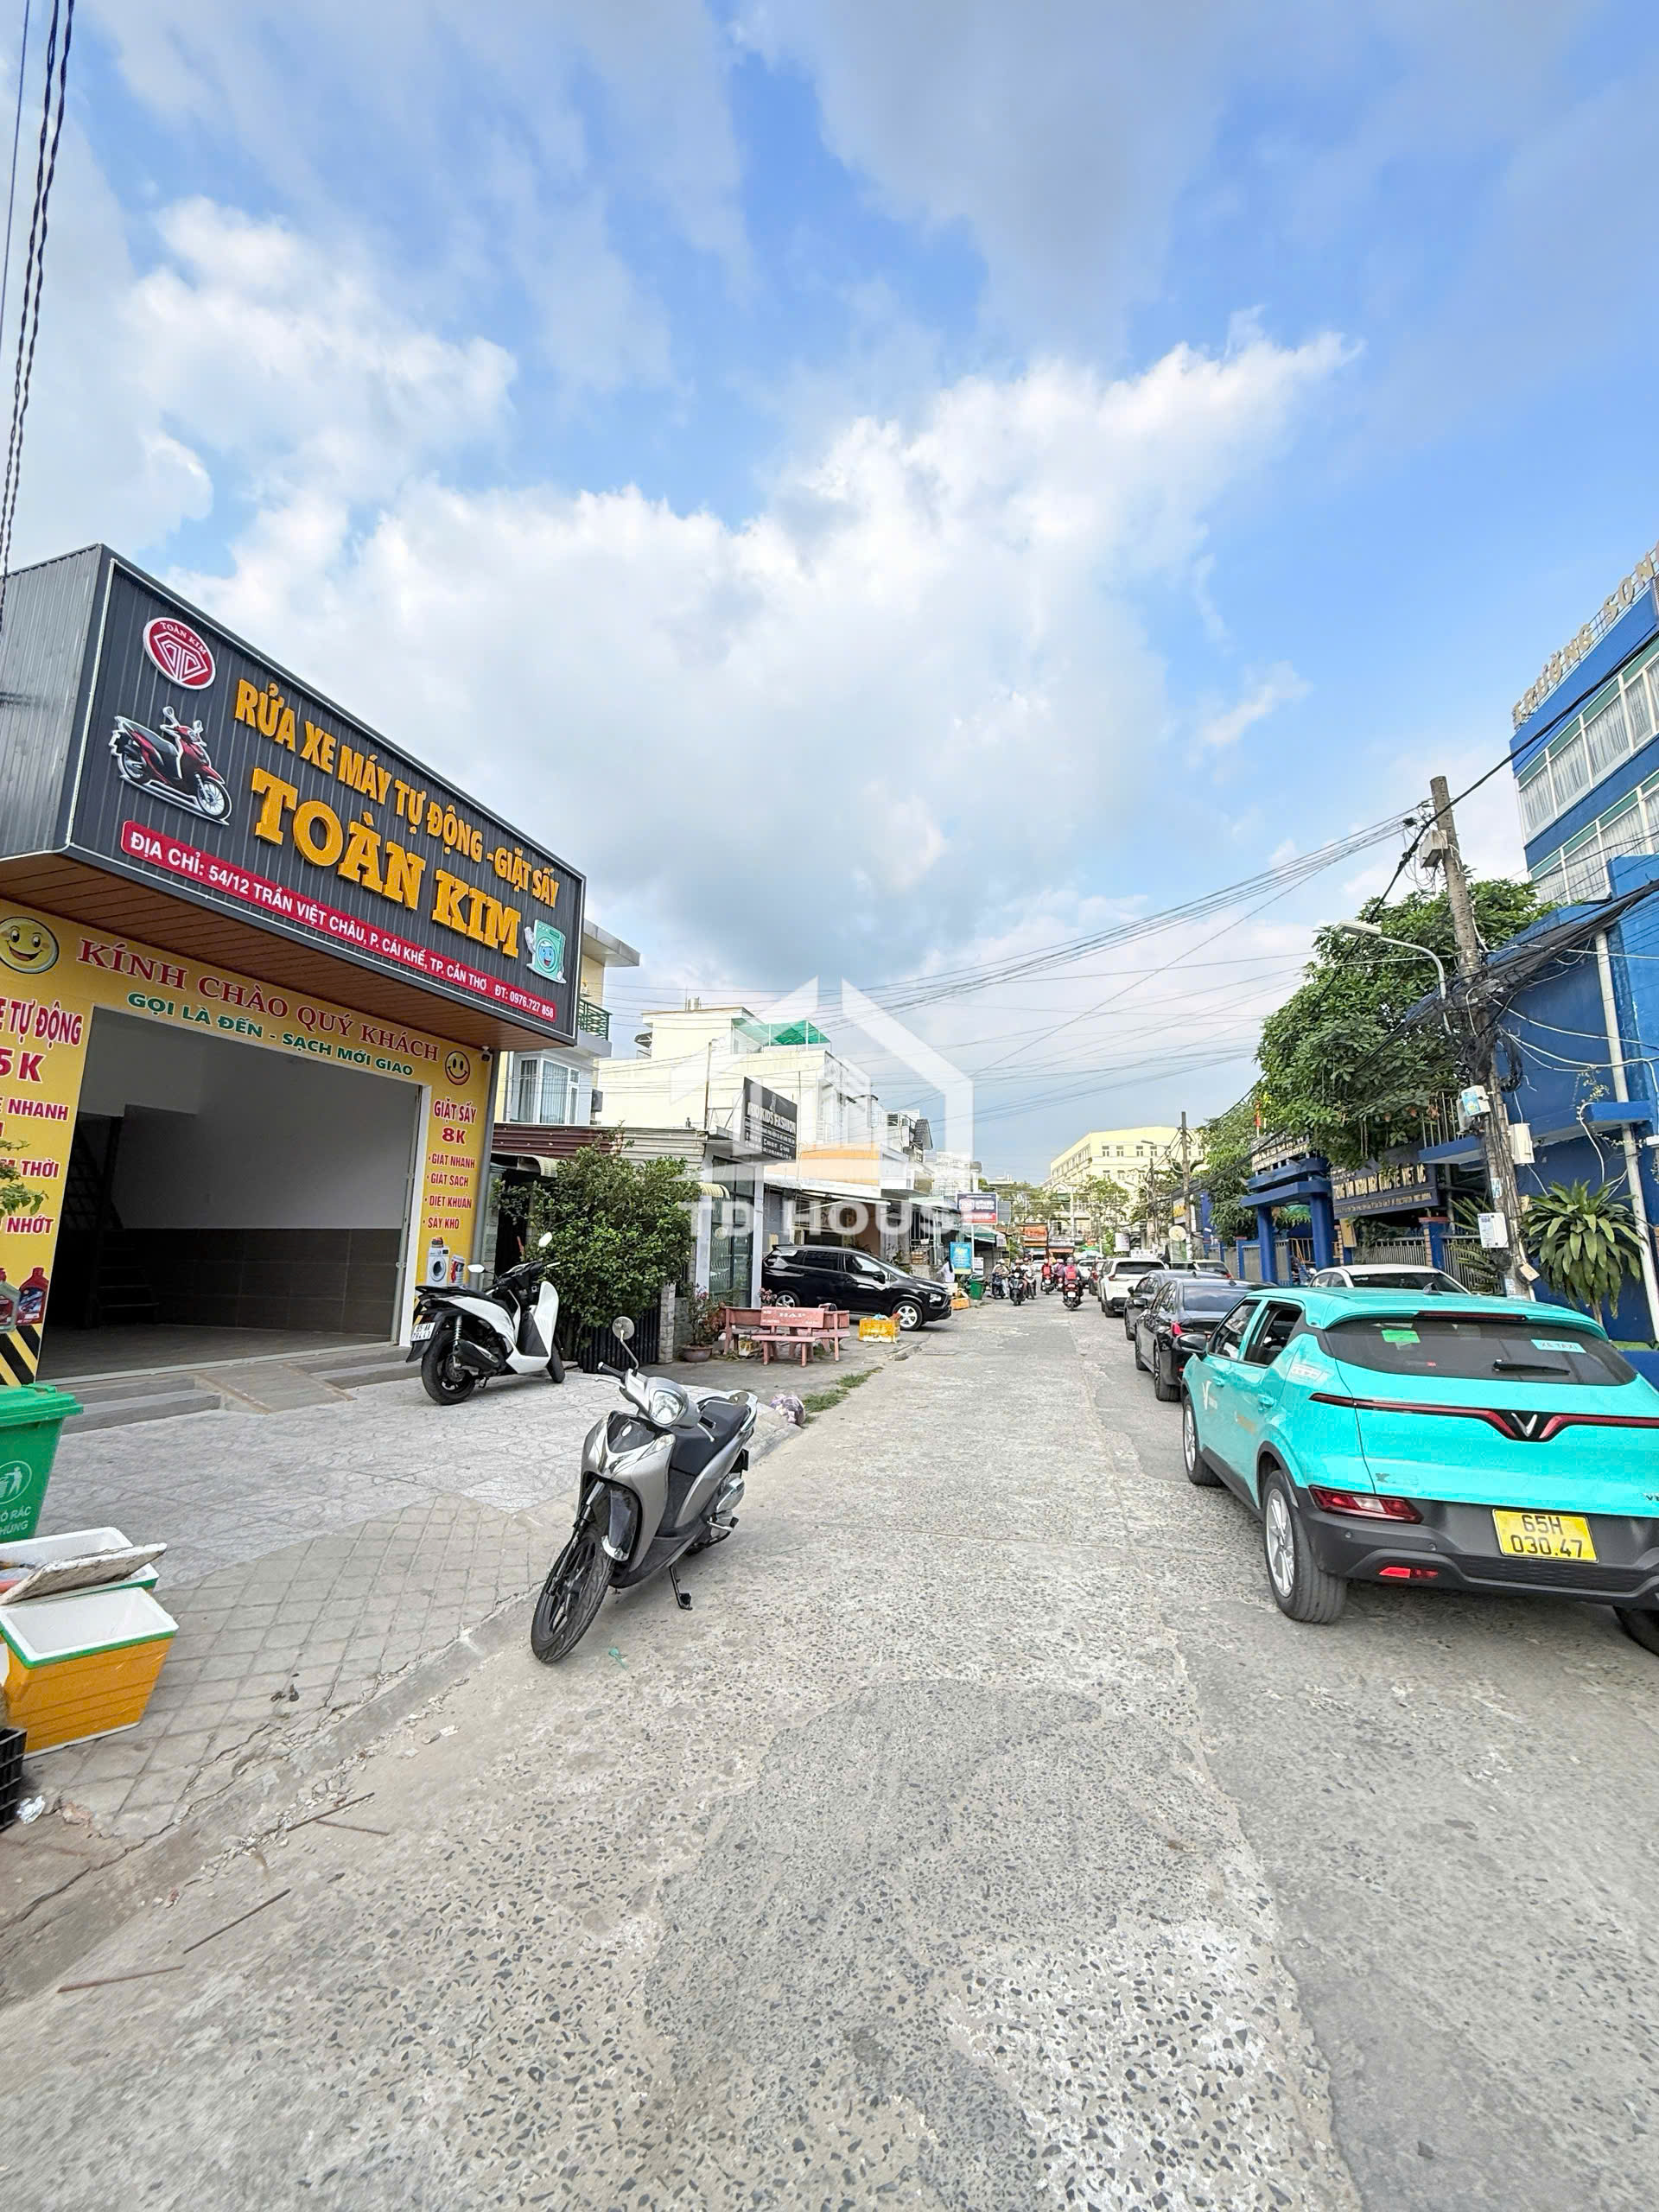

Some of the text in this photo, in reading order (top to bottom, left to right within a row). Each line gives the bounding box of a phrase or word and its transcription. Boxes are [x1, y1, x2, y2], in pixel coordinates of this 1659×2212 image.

[1603, 537, 1659, 624] SON
[160, 621, 207, 655] TOÀN KIM
[235, 679, 296, 752] RỬA
[300, 721, 336, 774] XE
[338, 745, 391, 805] MÁY
[394, 779, 427, 835] TỰ
[427, 801, 484, 863] ĐỘNG
[531, 867, 560, 908] SẤY
[251, 767, 521, 958] TOÀN KIM
[130, 831, 163, 860] ĐỊA
[168, 849, 204, 876] CHỈ:
[208, 866, 249, 895] 54/12
[253, 882, 292, 912] TRẦN
[296, 900, 327, 926] VIỆT
[329, 914, 366, 945] CHÂU,
[370, 932, 378, 948] P.
[382, 936, 401, 957] CÁI
[403, 945, 427, 969] KHẾ,
[429, 957, 444, 975] TP.
[468, 974, 487, 991] THƠ
[494, 983, 508, 1000] ĐT:
[509, 991, 541, 1013] 0976.727
[541, 1004, 554, 1019] 858
[76, 938, 439, 1063] KÍNH CHÀO QUÝ KHÁCH
[9, 1000, 36, 1045] TỰ
[34, 1000, 84, 1050] ĐỘNG
[127, 992, 175, 1016] GỌI
[181, 1005, 212, 1026] LÀ
[216, 1014, 264, 1038] ĐẾN
[282, 1033, 332, 1056] SẠCH
[337, 1046, 372, 1065] MỚI
[374, 1056, 414, 1077] GIAO
[7, 1098, 69, 1121] NHANH
[434, 1097, 477, 1124] GIẶT SẤY
[442, 1127, 467, 1145] 8K
[774, 1113, 796, 1135] FASHION
[21, 1159, 60, 1179] THỜI
[449, 1156, 475, 1169] NHANH
[6, 1216, 54, 1235] NHỚT
[1522, 1515, 1563, 1535] 65H
[1510, 1535, 1582, 1557] 030.47
